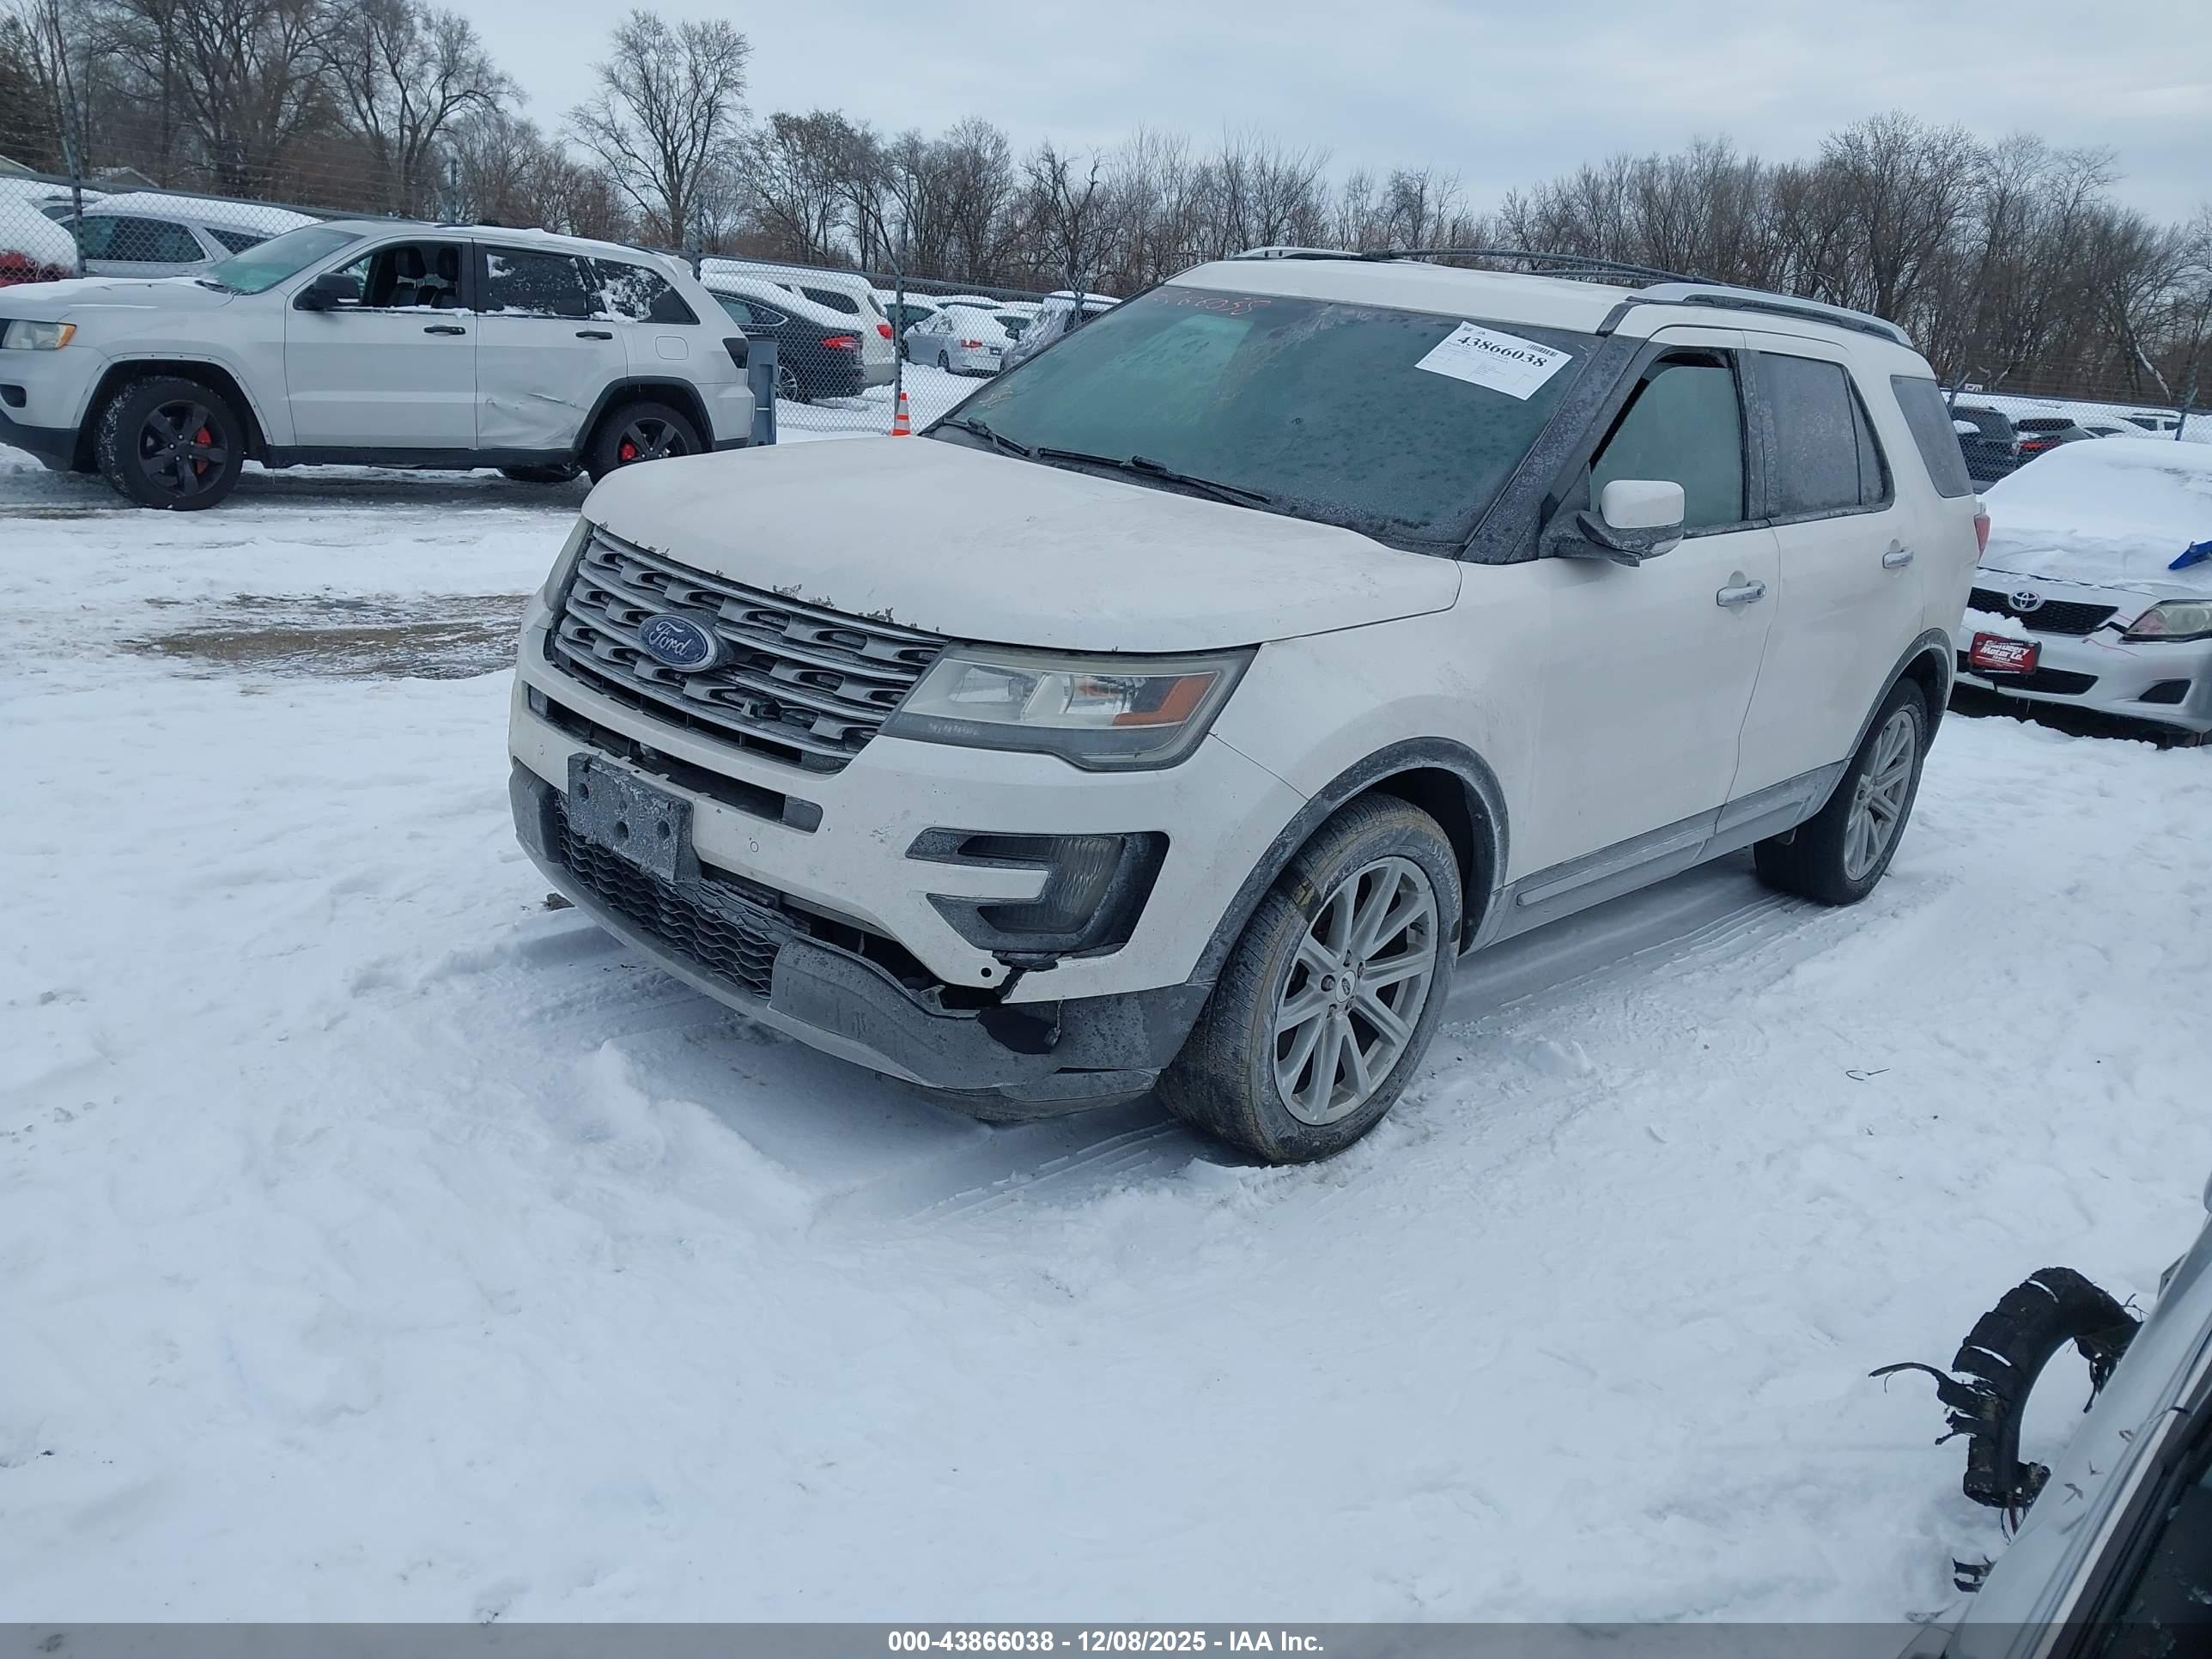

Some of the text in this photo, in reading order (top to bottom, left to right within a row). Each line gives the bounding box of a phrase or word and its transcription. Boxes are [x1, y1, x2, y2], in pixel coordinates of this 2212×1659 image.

[1457, 335, 1548, 368] 43866038
[648, 621, 692, 656] Ford
[1980, 646, 2011, 658] Motor
